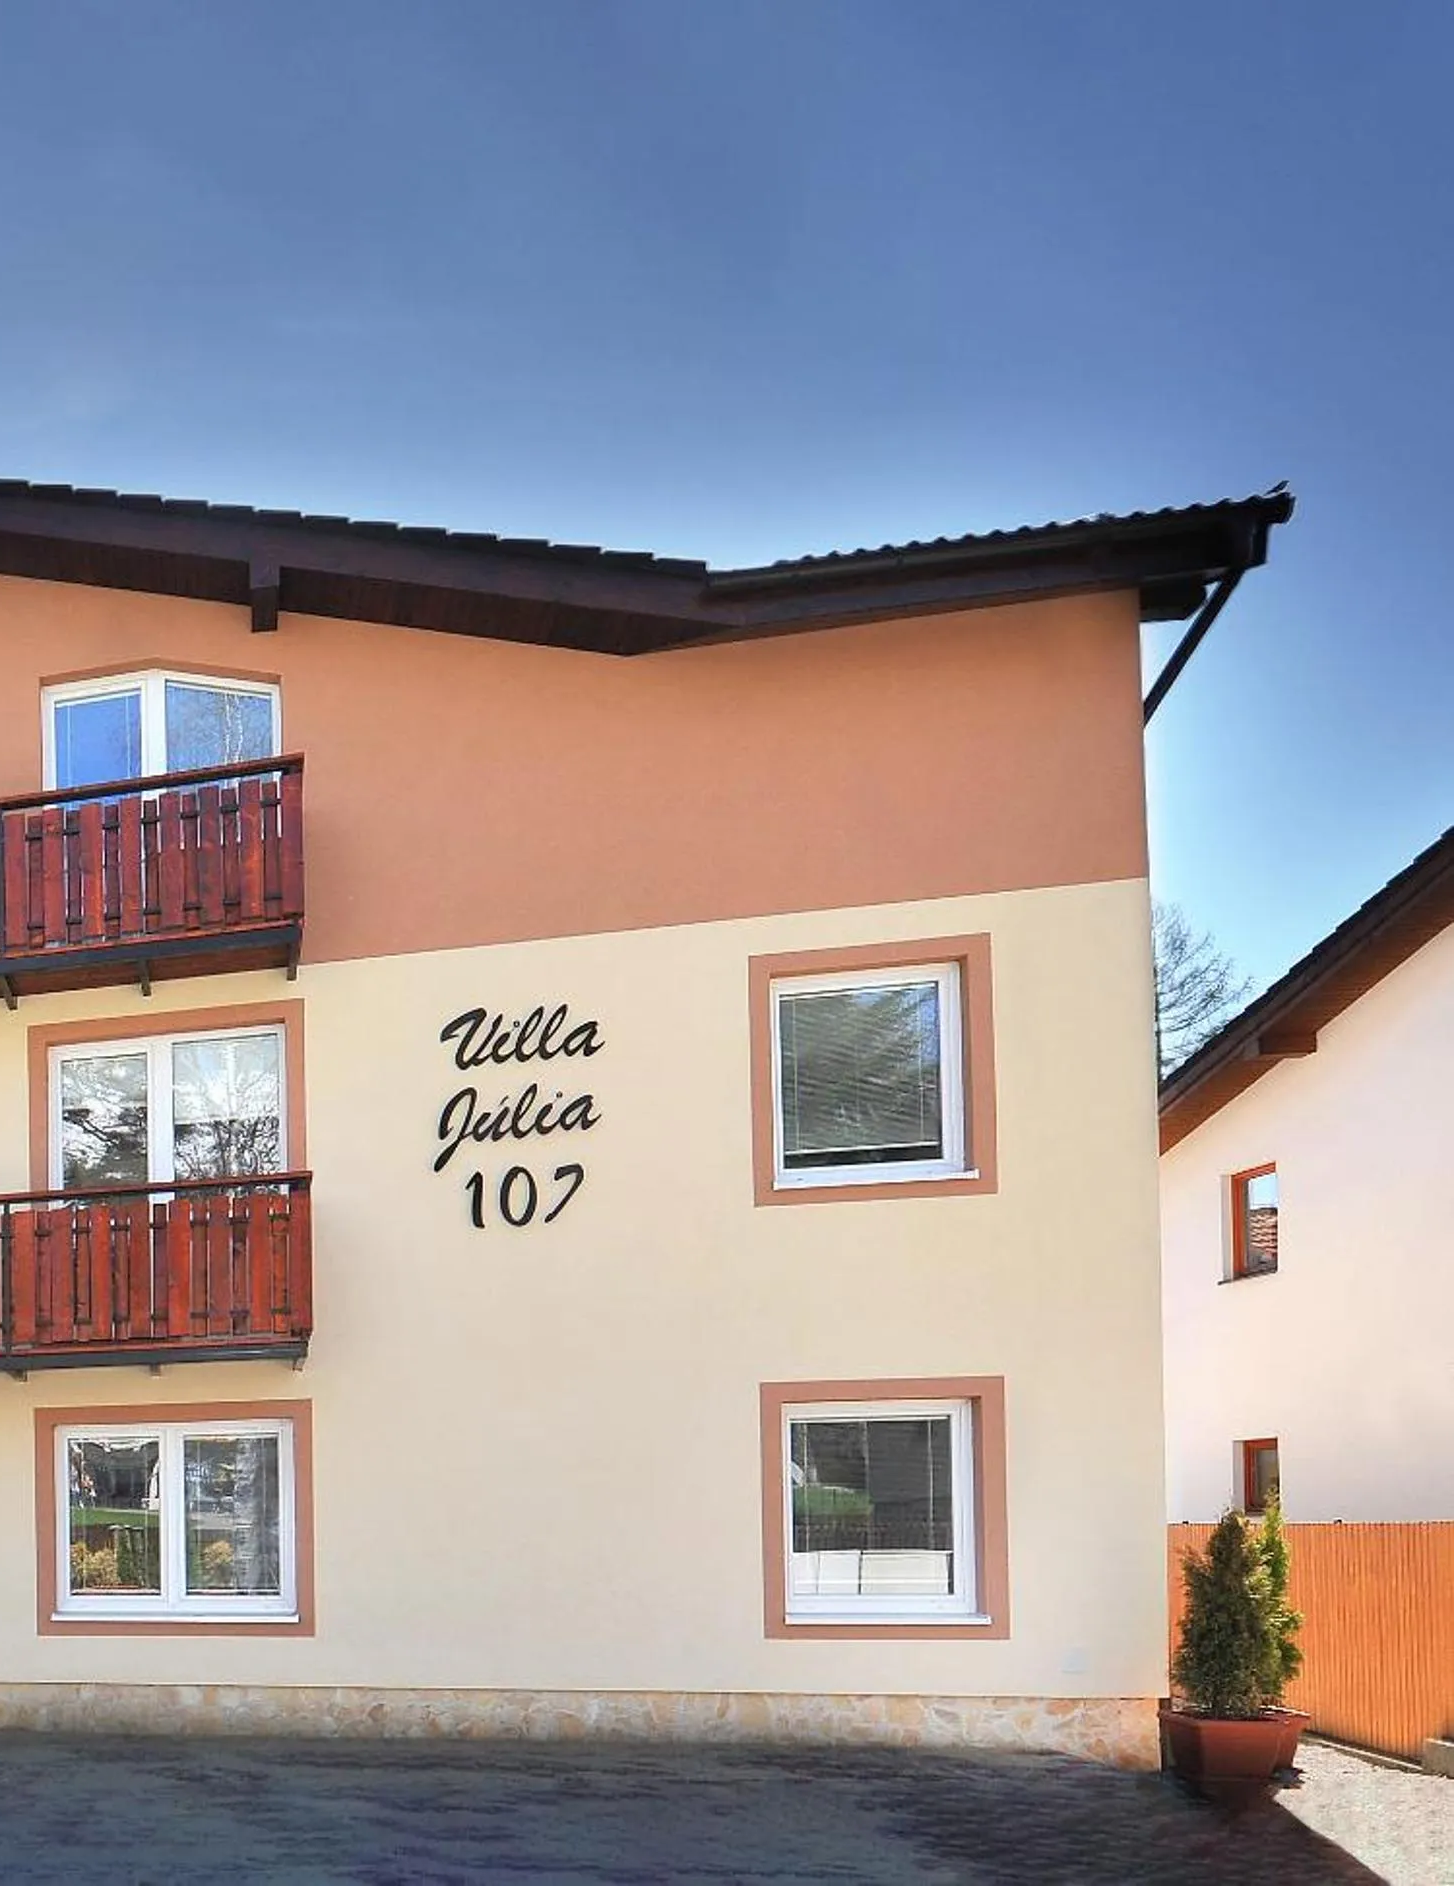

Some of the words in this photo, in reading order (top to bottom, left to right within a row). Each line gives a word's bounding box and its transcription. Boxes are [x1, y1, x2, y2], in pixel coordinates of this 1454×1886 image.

[439, 1003, 606, 1071] Villa
[433, 1083, 602, 1173] Júlia
[465, 1163, 585, 1229] 107
